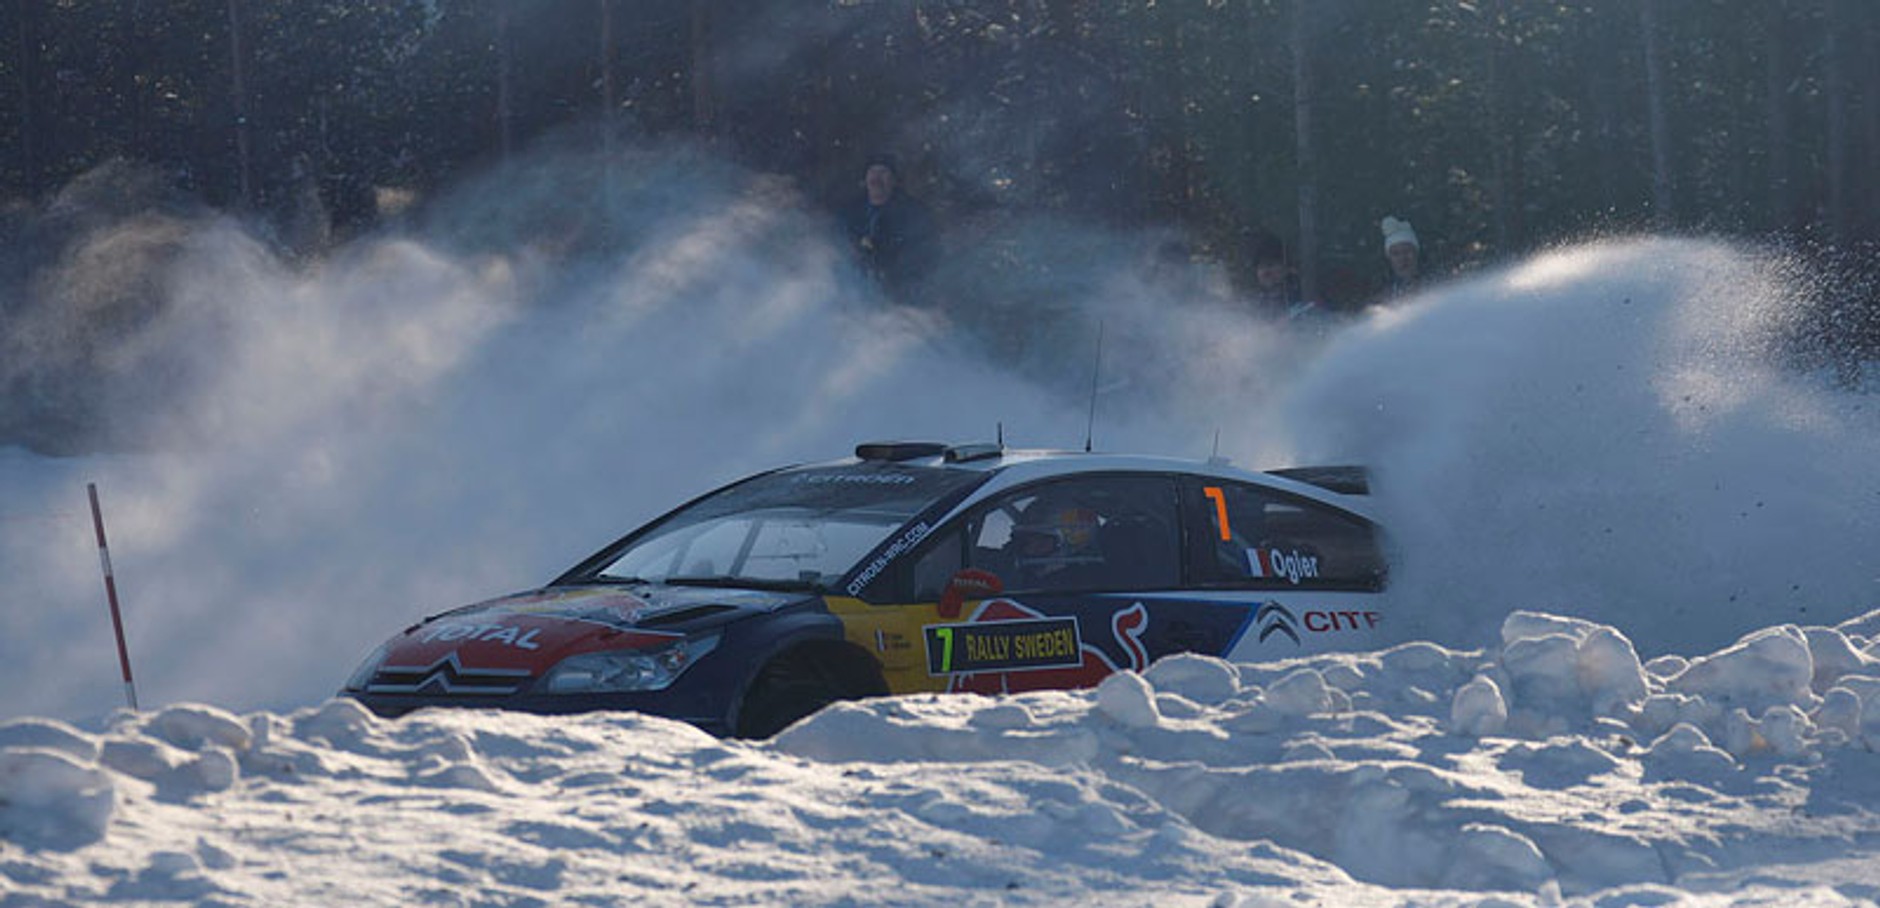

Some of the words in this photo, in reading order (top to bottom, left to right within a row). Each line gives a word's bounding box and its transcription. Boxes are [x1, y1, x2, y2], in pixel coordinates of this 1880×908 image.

[1203, 486, 1232, 541] 7
[1270, 548, 1319, 585] Ogier
[421, 622, 542, 650] TOTAL
[936, 627, 953, 673] 7
[966, 633, 1010, 661] RALLY
[1014, 627, 1075, 659] SWEDEN
